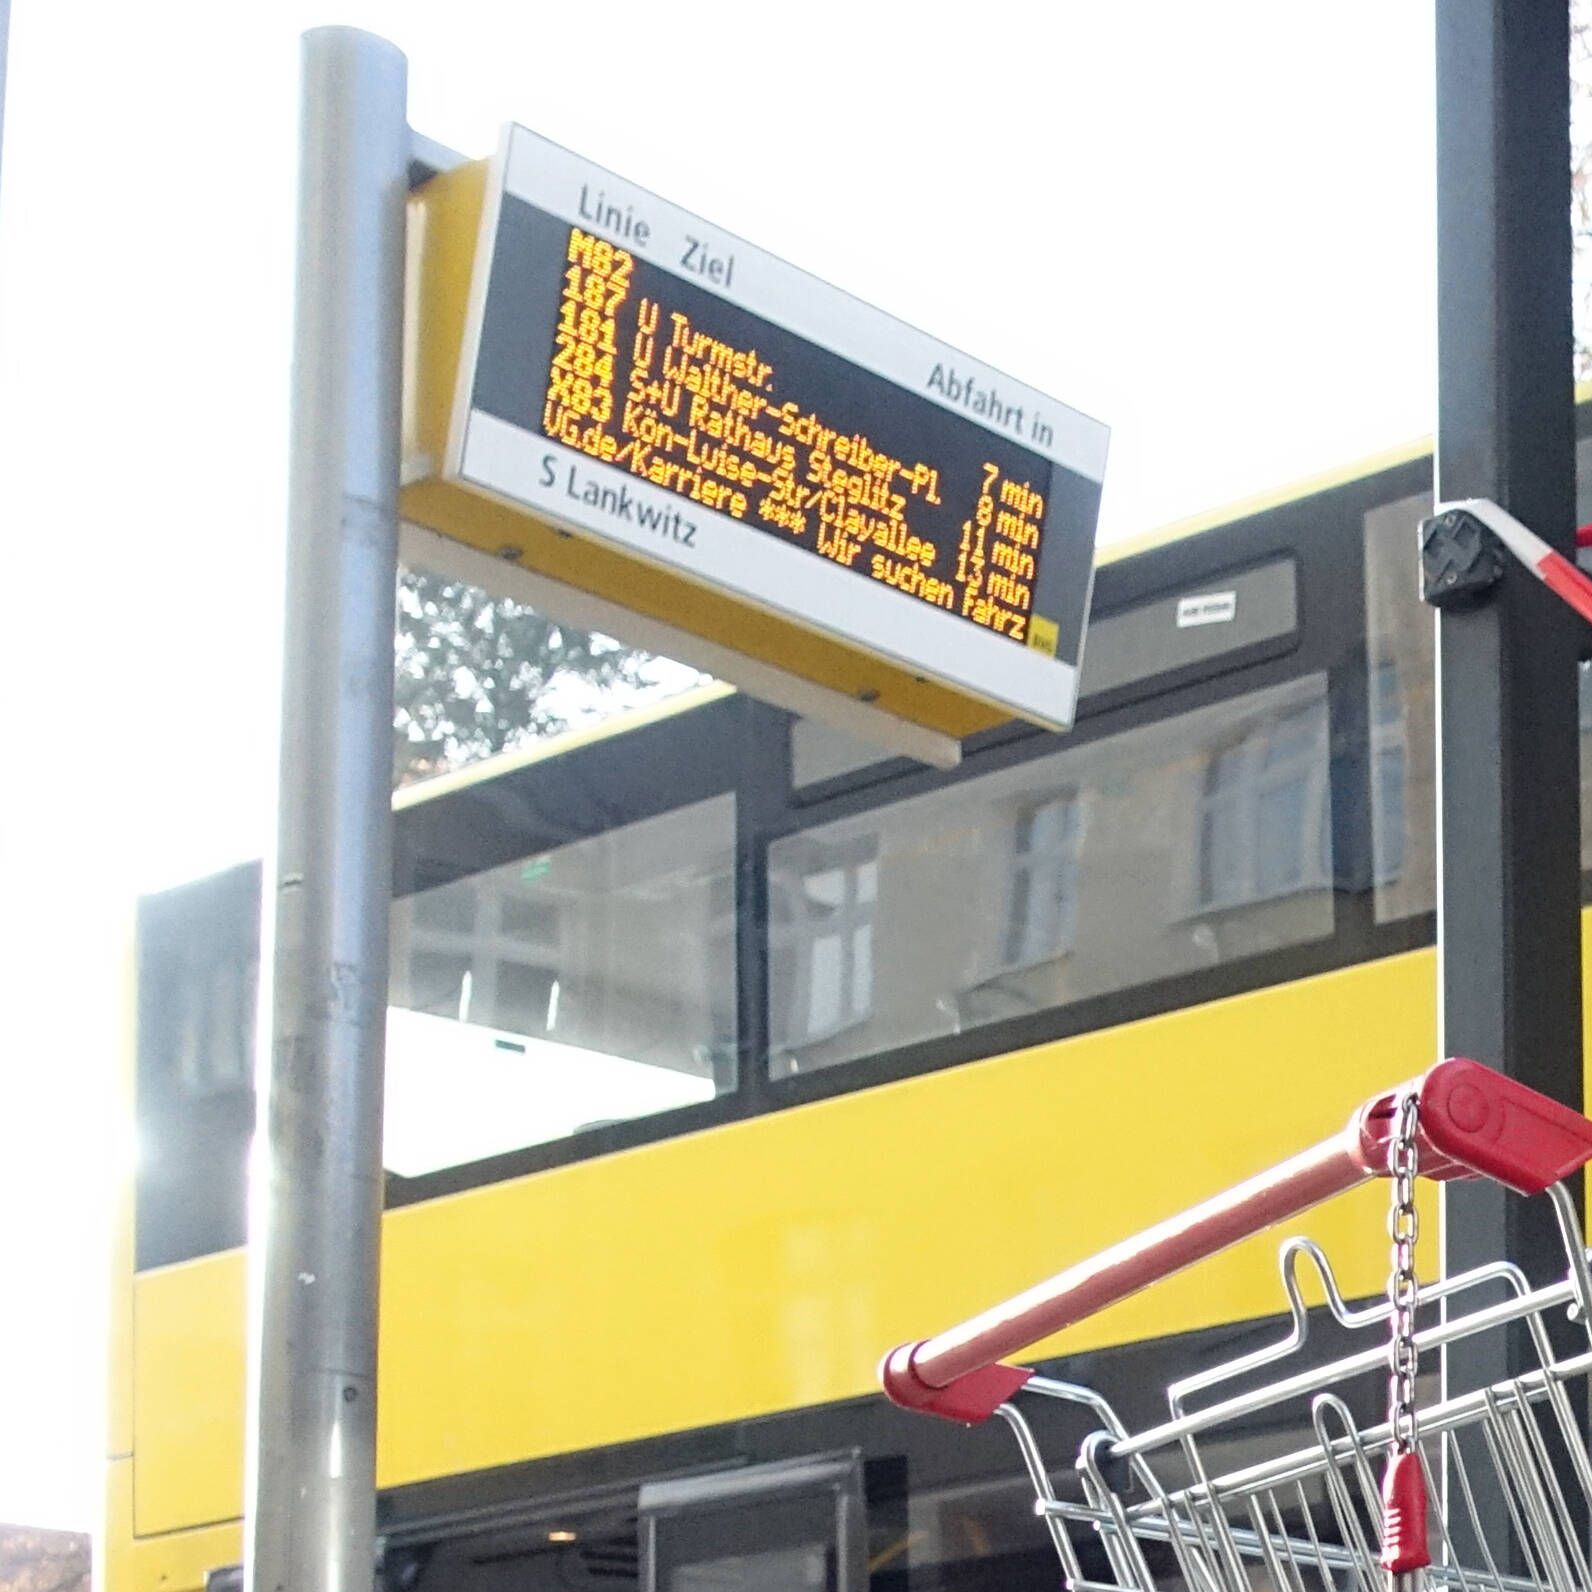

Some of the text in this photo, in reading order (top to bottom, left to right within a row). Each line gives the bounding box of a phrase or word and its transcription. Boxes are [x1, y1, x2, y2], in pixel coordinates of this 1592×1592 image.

[567, 228, 633, 288] M82
[579, 184, 1054, 448] Linie Ziel Abfahrt in
[539, 454, 697, 548] S Lankwitz
[546, 365, 1031, 610] X83 Kön-Luise-Str/Clayallee 13 min
[551, 331, 1036, 580] 284 S+U Rathaus Steglitz 11 min
[557, 298, 1040, 549] 181 U Walther-Schreiber-Pl. 8 min
[562, 264, 1043, 518] 187 U Turmstr. 7 min
[816, 518, 861, 566] Wir
[870, 553, 958, 609] suchen
